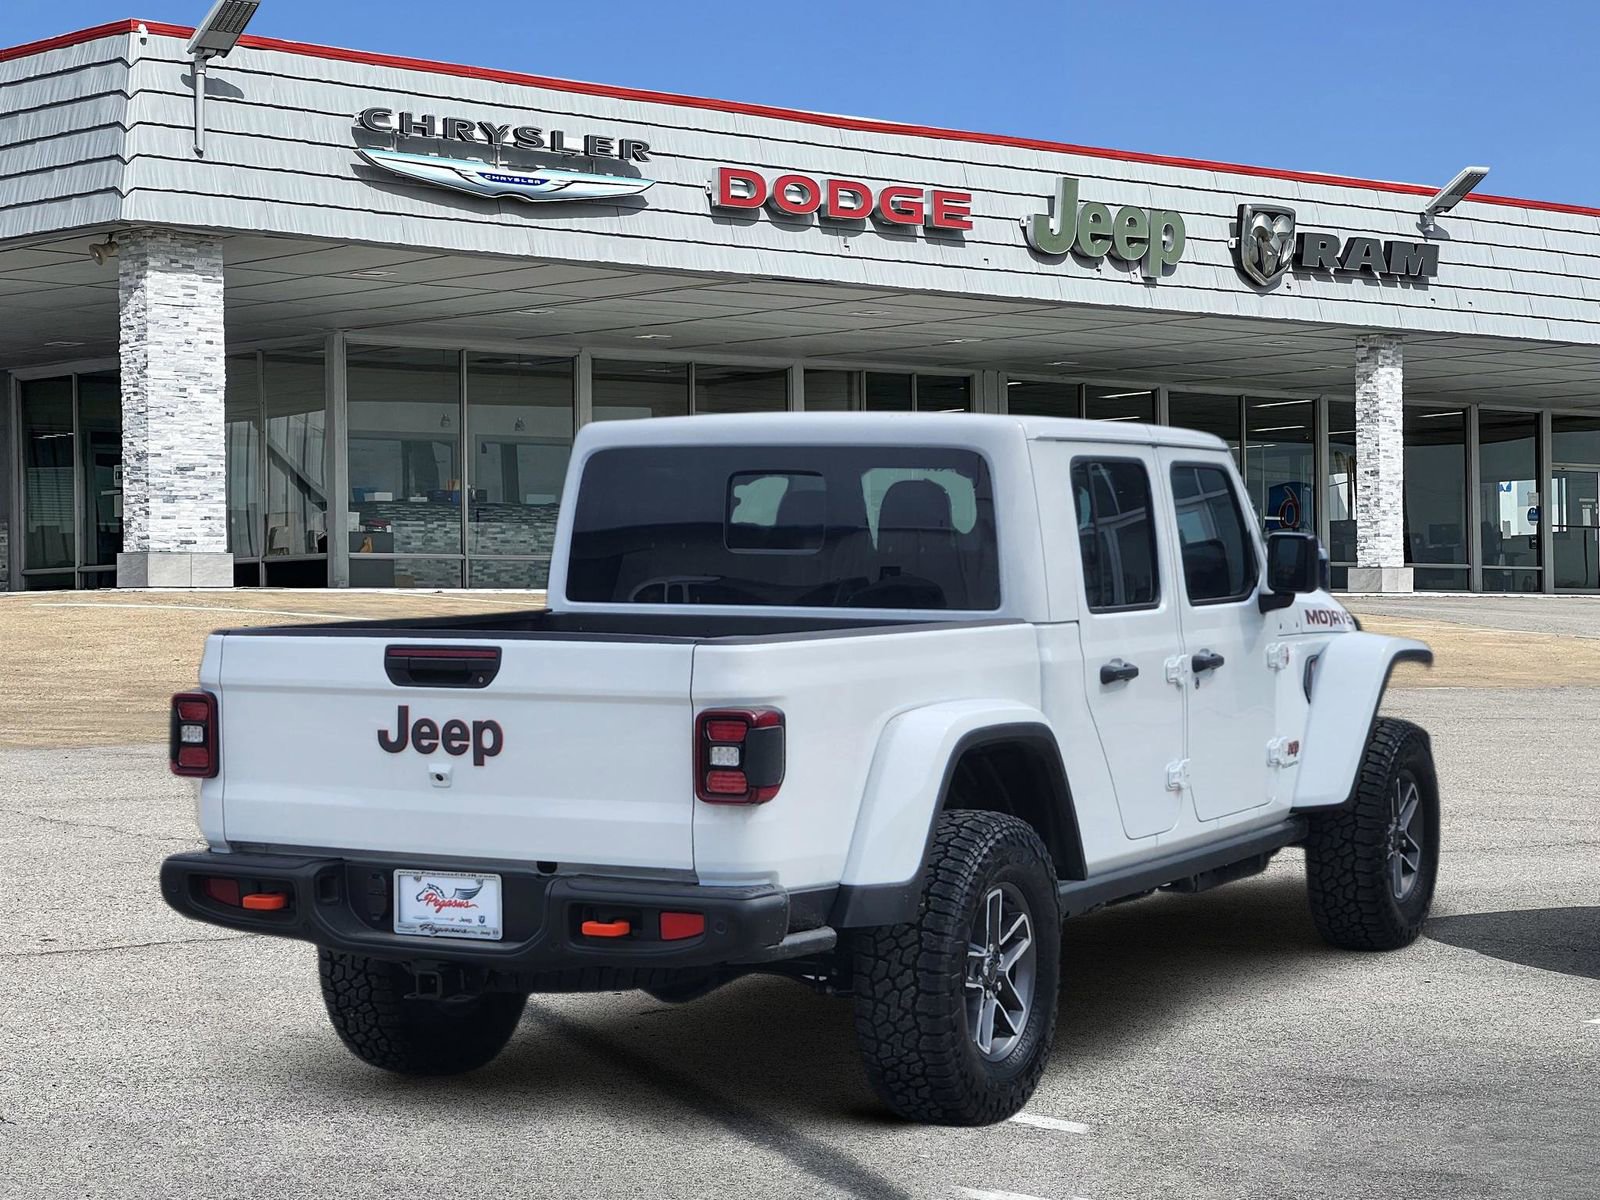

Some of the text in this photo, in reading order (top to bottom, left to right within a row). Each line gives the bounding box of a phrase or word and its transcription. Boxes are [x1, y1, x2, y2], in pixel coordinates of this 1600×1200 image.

[358, 106, 651, 162] CHRYSLER
[484, 174, 541, 185] CHRYSLER
[714, 167, 973, 230] DODGE
[1027, 176, 1186, 278] Jeep
[1297, 231, 1440, 278] RAM
[1304, 609, 1353, 627] MOJAVE
[377, 705, 504, 766] Jeep
[422, 892, 478, 914] Pegasus
